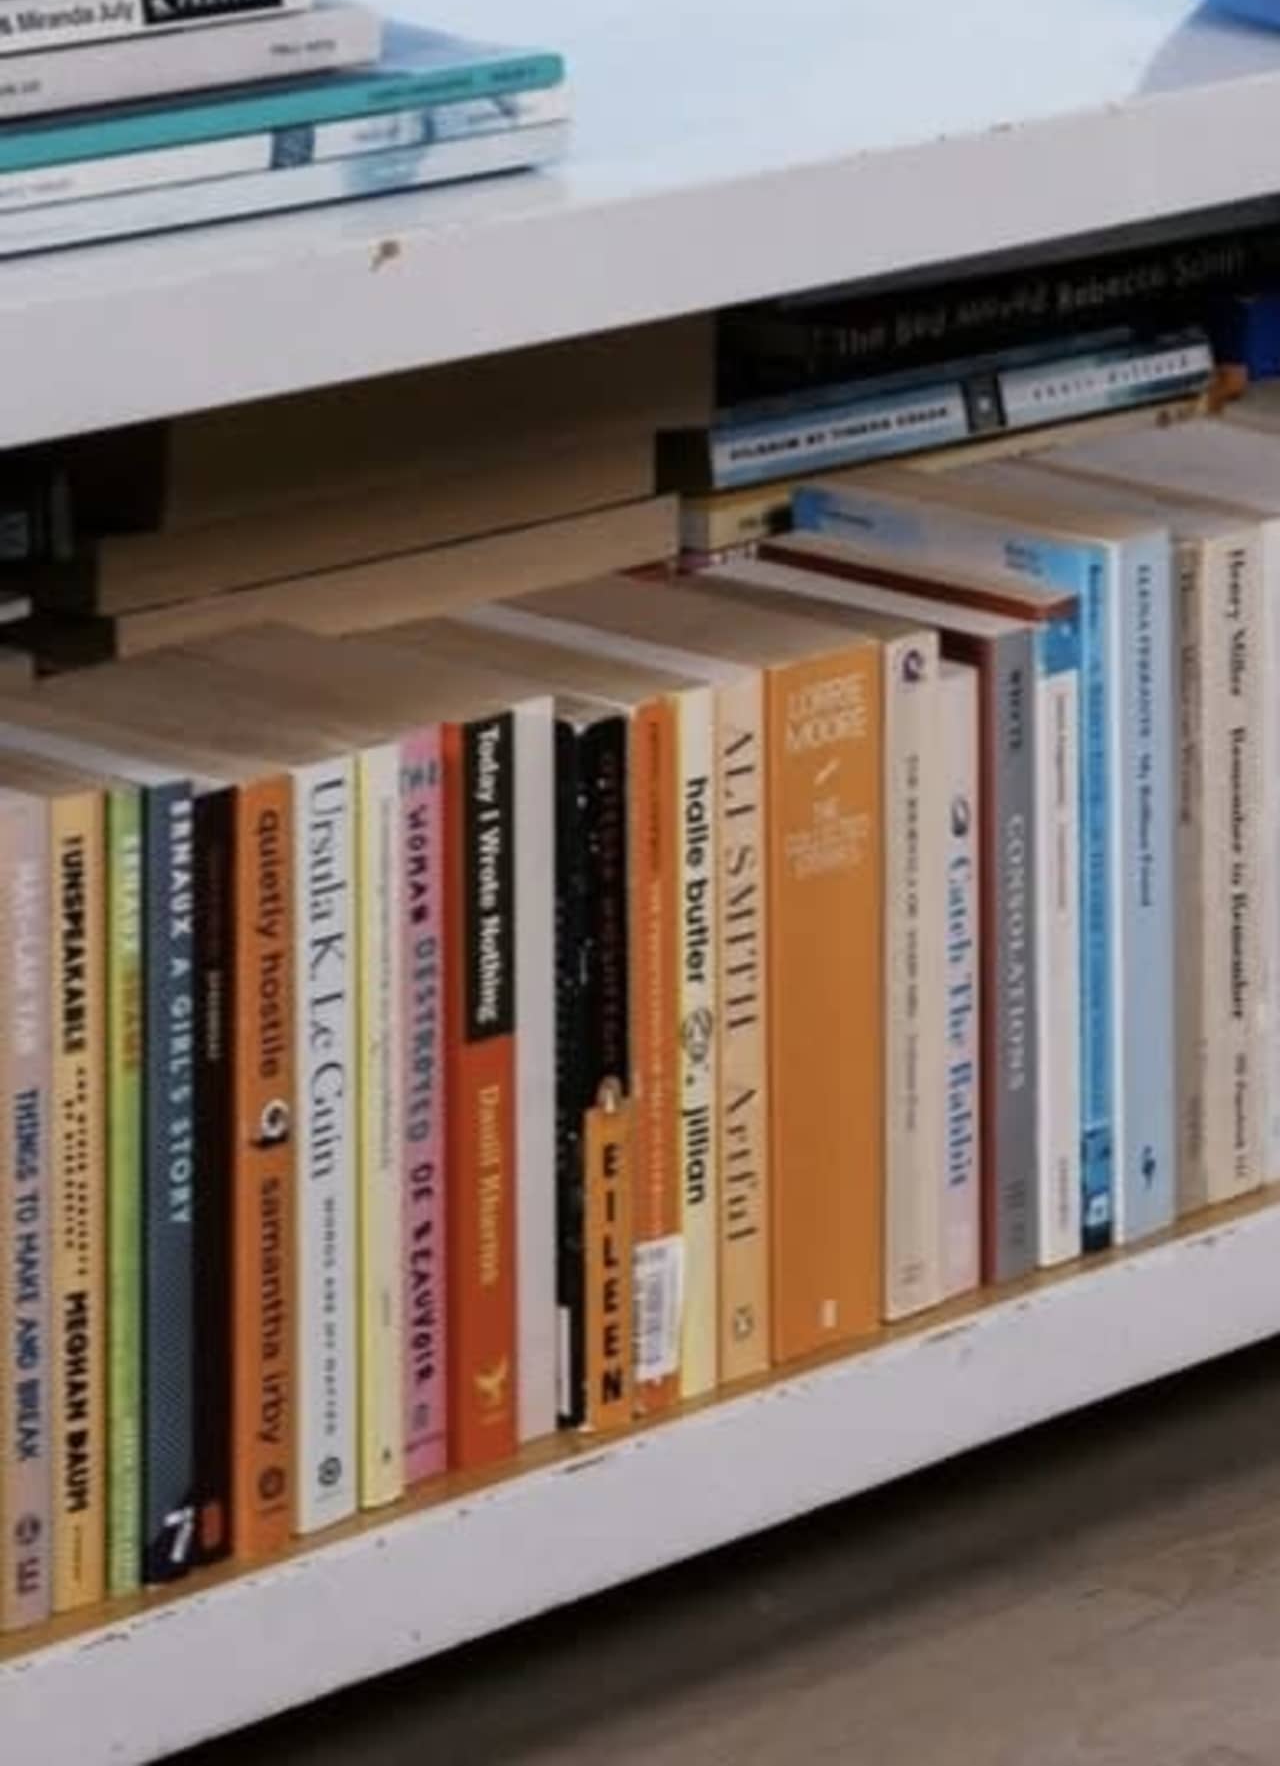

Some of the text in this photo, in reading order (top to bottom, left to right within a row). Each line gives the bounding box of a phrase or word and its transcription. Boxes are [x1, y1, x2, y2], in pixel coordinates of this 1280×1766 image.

[1224, 548, 1246, 621] Henry
[1229, 628, 1247, 697] Miller
[307, 777, 348, 925] Ursula
[722, 731, 758, 820] ALI
[1229, 726, 1247, 854] Remember
[256, 809, 286, 1080] quietly hostile
[406, 803, 430, 926] WOMAN
[475, 725, 501, 1024] Today I Wrote Nothing
[686, 776, 709, 984] halle butler
[722, 843, 758, 1030] SMITH
[61, 849, 86, 1056] UNSPEAKABLE
[168, 798, 194, 1223] ERNAUX A GIRL'S STORY
[308, 991, 346, 1051] Le
[948, 855, 974, 1190] Catch The Rabbit
[1005, 814, 1026, 1091] CONSOLATIONS
[310, 1062, 345, 1180] Guin
[406, 937, 437, 1142] DESTROYED
[15, 1088, 40, 1181] THINGS
[15, 1193, 39, 1222] TO
[681, 1104, 709, 1206] jillian
[15, 1232, 39, 1305] MAKE
[256, 1176, 288, 1445] samantha irby
[408, 1162, 436, 1387] DE BEAUVOIR
[602, 1141, 624, 1406] EILEEN
[14, 1379, 39, 1462] BREAK
[64, 1291, 89, 1515] MEGHAN DAUM
